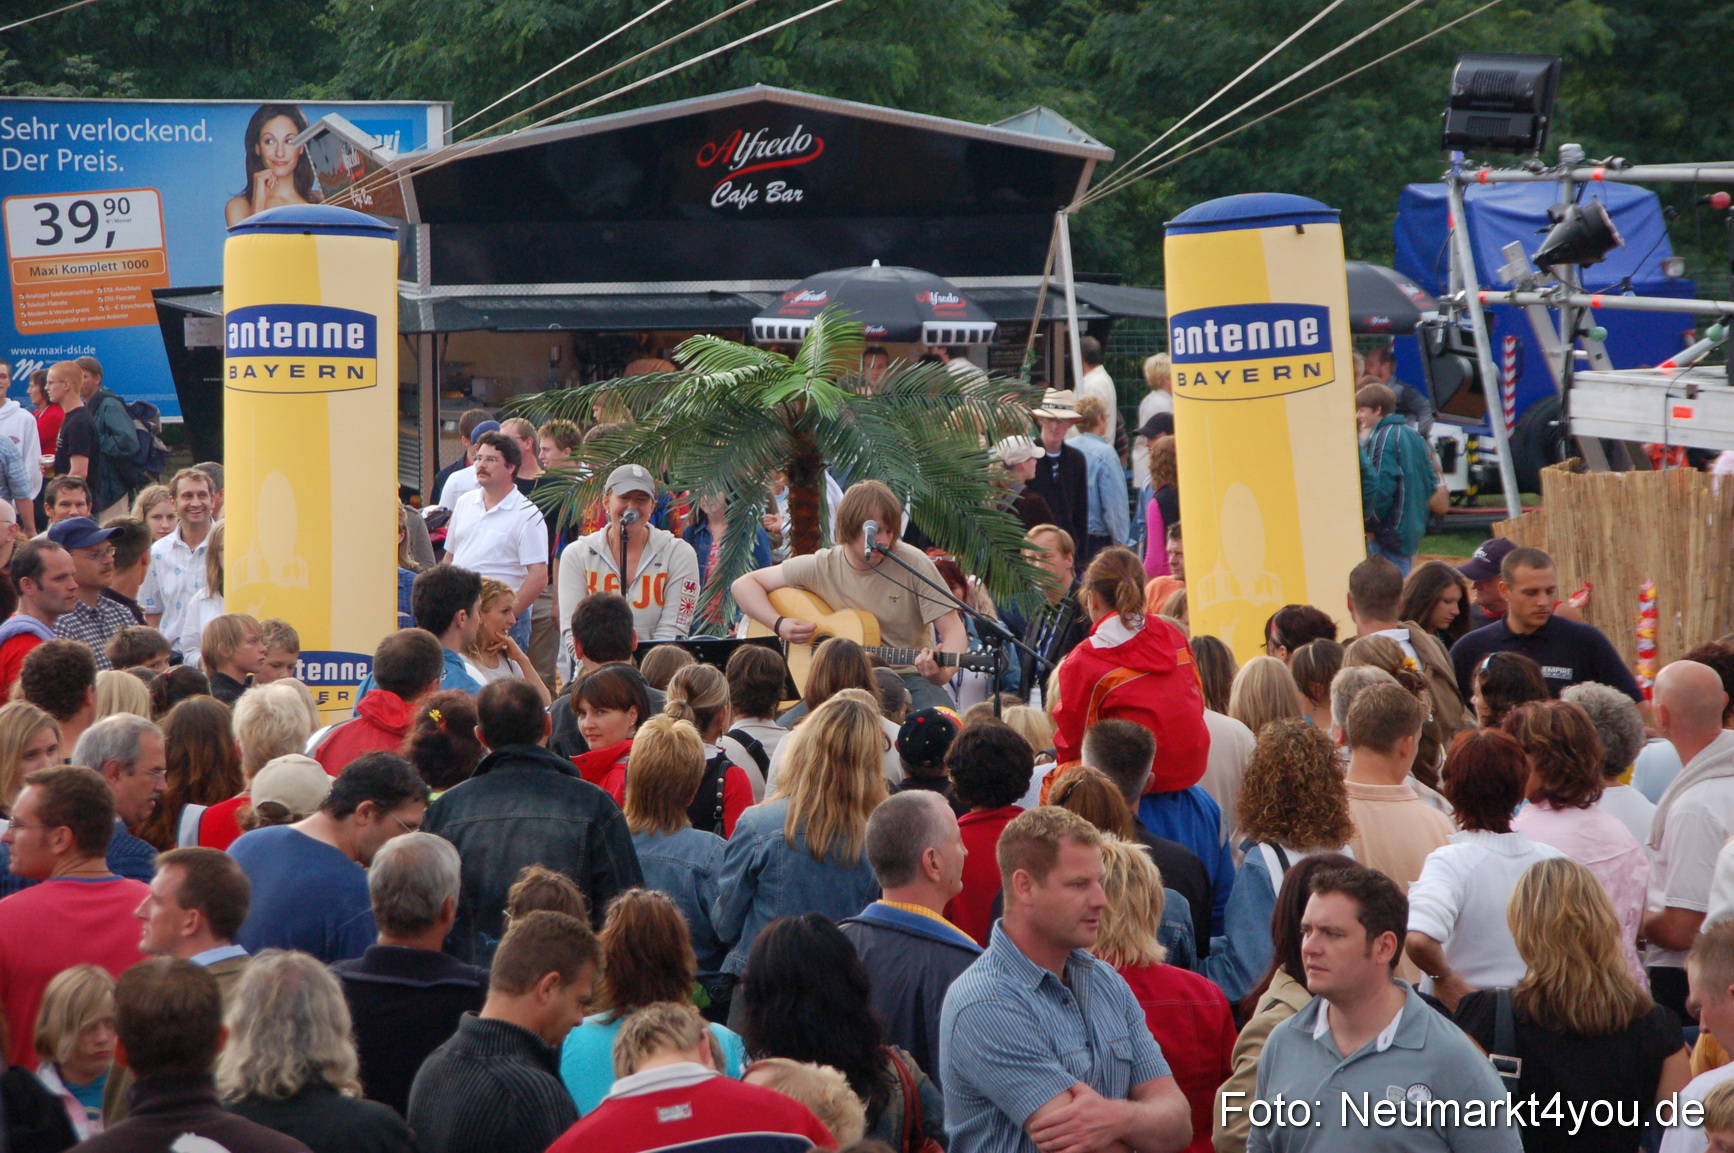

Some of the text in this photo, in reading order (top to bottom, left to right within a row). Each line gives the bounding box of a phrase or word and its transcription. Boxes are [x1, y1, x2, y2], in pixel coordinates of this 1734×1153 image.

[1, 116, 213, 142] Sehr verlockend.
[696, 124, 812, 171] Alfredo
[2, 148, 124, 172] Der Preis.
[710, 181, 804, 211] Cafe Bar
[29, 259, 149, 277] Maxi Komplett 1000
[915, 291, 960, 305] Alfredo
[228, 316, 365, 349] antenne
[1174, 317, 1319, 355] antenne
[10, 345, 96, 355] www.maxi-dsl.de
[229, 364, 365, 380] BAYERN
[1177, 362, 1321, 387] BAYERN
[295, 658, 368, 681] tenne
